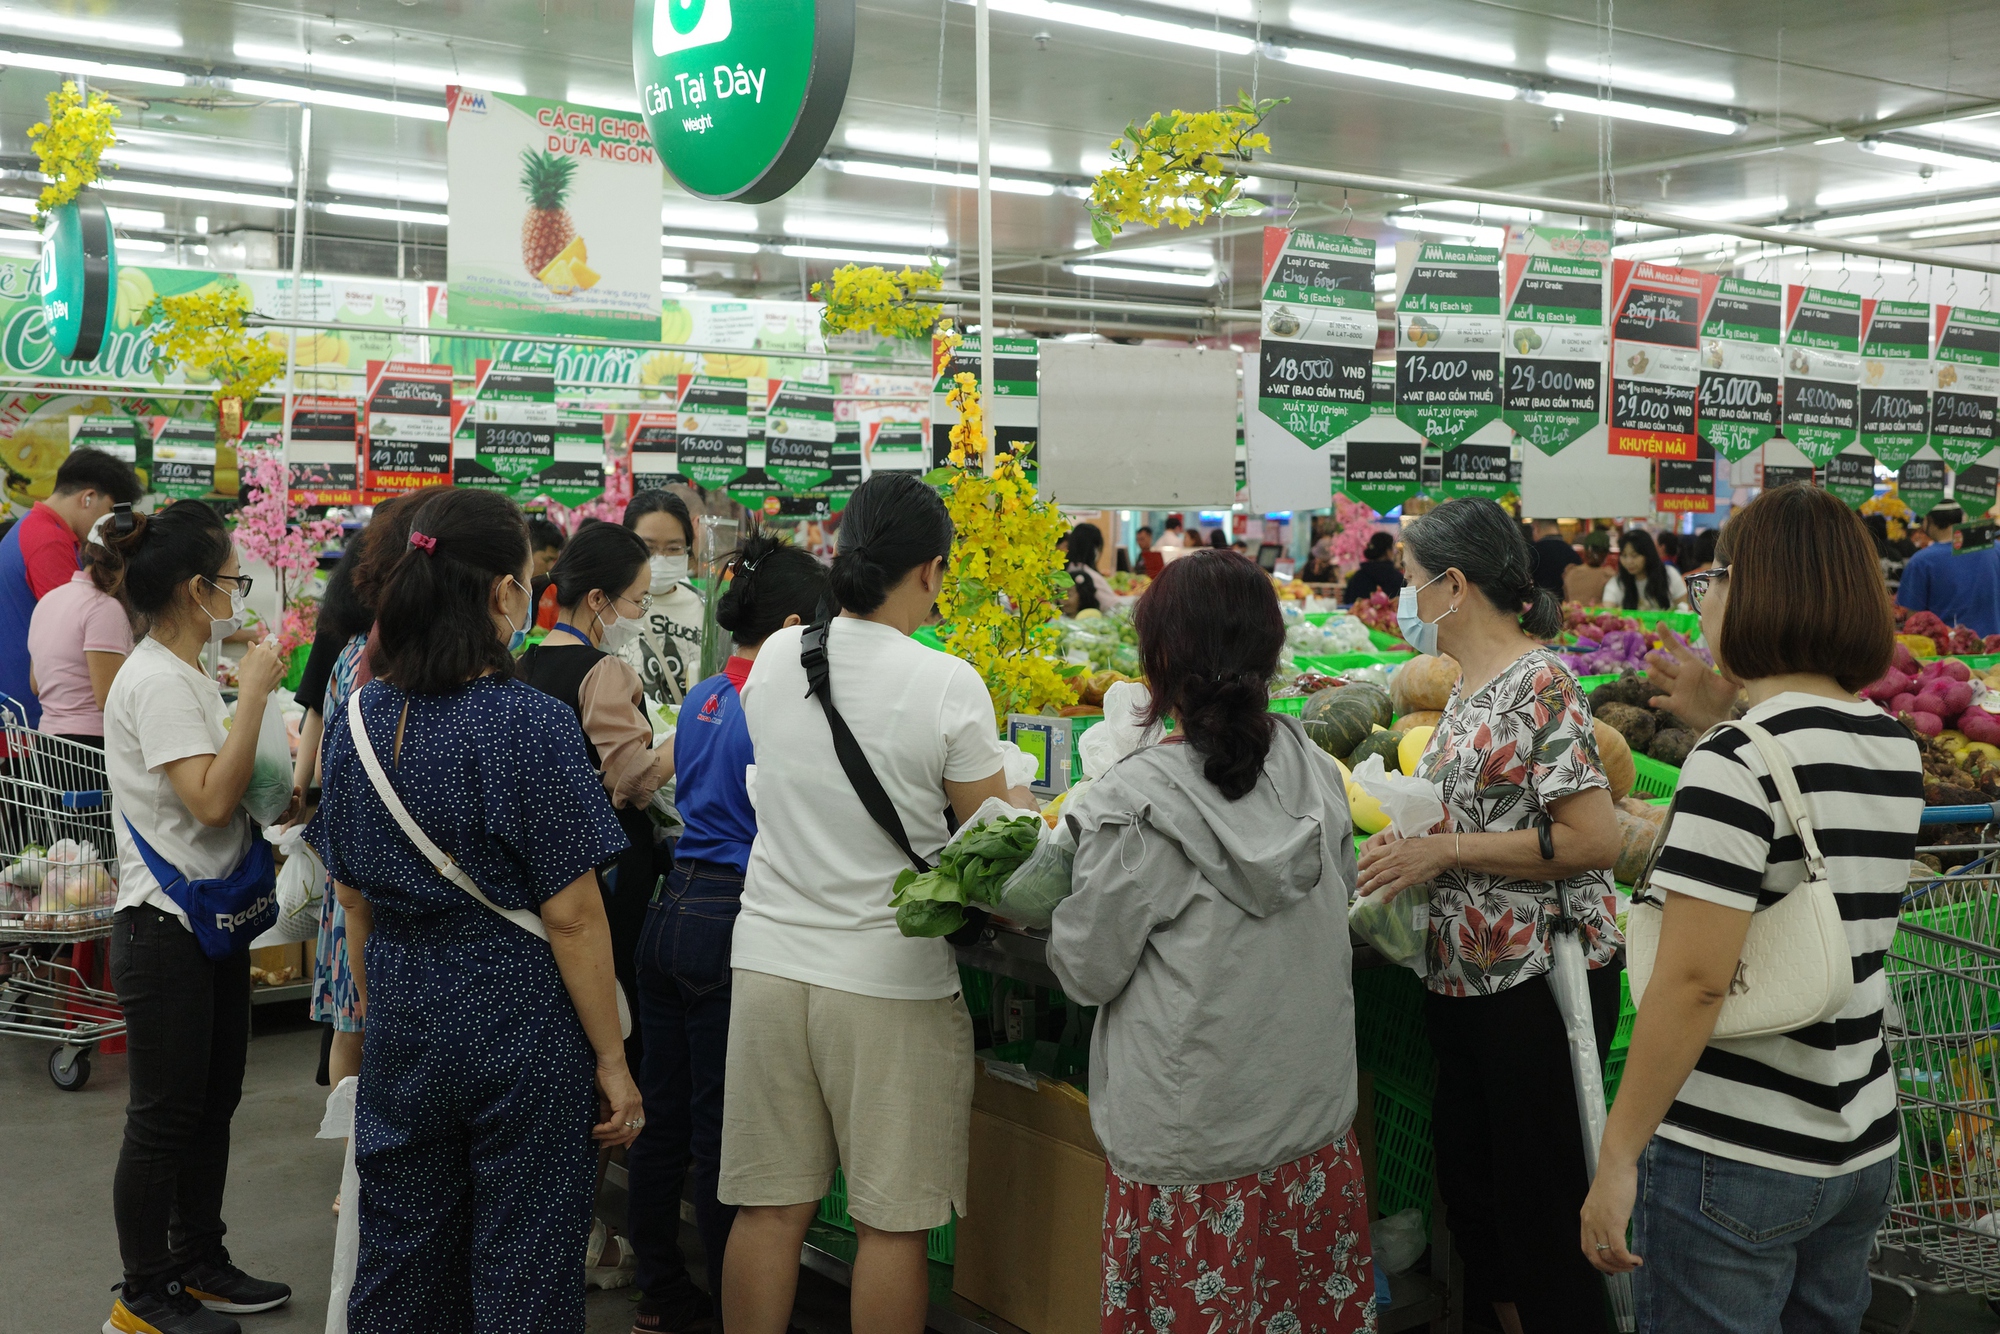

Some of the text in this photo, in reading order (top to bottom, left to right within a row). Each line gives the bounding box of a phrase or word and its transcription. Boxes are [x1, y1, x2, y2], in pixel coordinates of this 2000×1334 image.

[645, 62, 766, 116] Cân Tại Đây
[538, 107, 594, 133] CÁCH
[682, 113, 714, 134] Weight
[548, 133, 593, 157] DỨA
[1287, 257, 1330, 270] Loại Grade:
[1418, 269, 1458, 278] Loại Grade:
[1299, 292, 1308, 303] Kg
[1310, 293, 1332, 303] (Each
[1430, 302, 1438, 312] Kg
[1440, 302, 1460, 311] (Each
[1342, 366, 1366, 379] VNĐ
[1405, 355, 1494, 382] 13.000 VNĐ
[1511, 365, 1595, 392] 28.000 VNĐ
[1267, 383, 1365, 402] +VAT (BAO GỒM THUẾ)
[1402, 387, 1493, 402] +VAT (BAO GỒM THUẾ)
[1698, 377, 1762, 406] 45.000
[1510, 395, 1594, 410] +VAT (BAO GỒM THUẾ)
[1796, 387, 1853, 411] 48.000 VNĐ
[1283, 400, 1305, 412] XUẤT
[1321, 405, 1348, 417] (Origin):
[1418, 405, 1437, 416] XUẤT
[1453, 409, 1478, 418] (Origin):
[1617, 395, 1692, 419] 29.000 VNĐ
[1524, 412, 1542, 423] XUẤT
[1701, 407, 1772, 423] +VAT (BAO GỒM THUẾ)
[1788, 413, 1803, 422] +VAT
[1804, 414, 1819, 424] (BAO
[1835, 414, 1852, 427] THUẾ)
[1979, 409, 1994, 420] VNĐ
[1622, 420, 1636, 428] +VAT
[1637, 421, 1651, 430] (BAO
[1667, 422, 1684, 434] THUẾ)
[532, 434, 550, 443] VNĐ
[681, 436, 723, 452] 15.000
[1620, 433, 1686, 455] KHUYẾN MÃI
[498, 446, 513, 454] (BAO
[530, 446, 550, 455] THUẾ)
[429, 454, 447, 463] VNĐ
[1400, 455, 1417, 465] VNĐ
[1491, 458, 1507, 466] VNĐ
[377, 474, 420, 487] KHUYẾN
[334, 492, 351, 503] MÃI
[1695, 498, 1708, 510] MÃI
[216, 887, 276, 933] Reebo
[253, 907, 277, 927] CLAS
